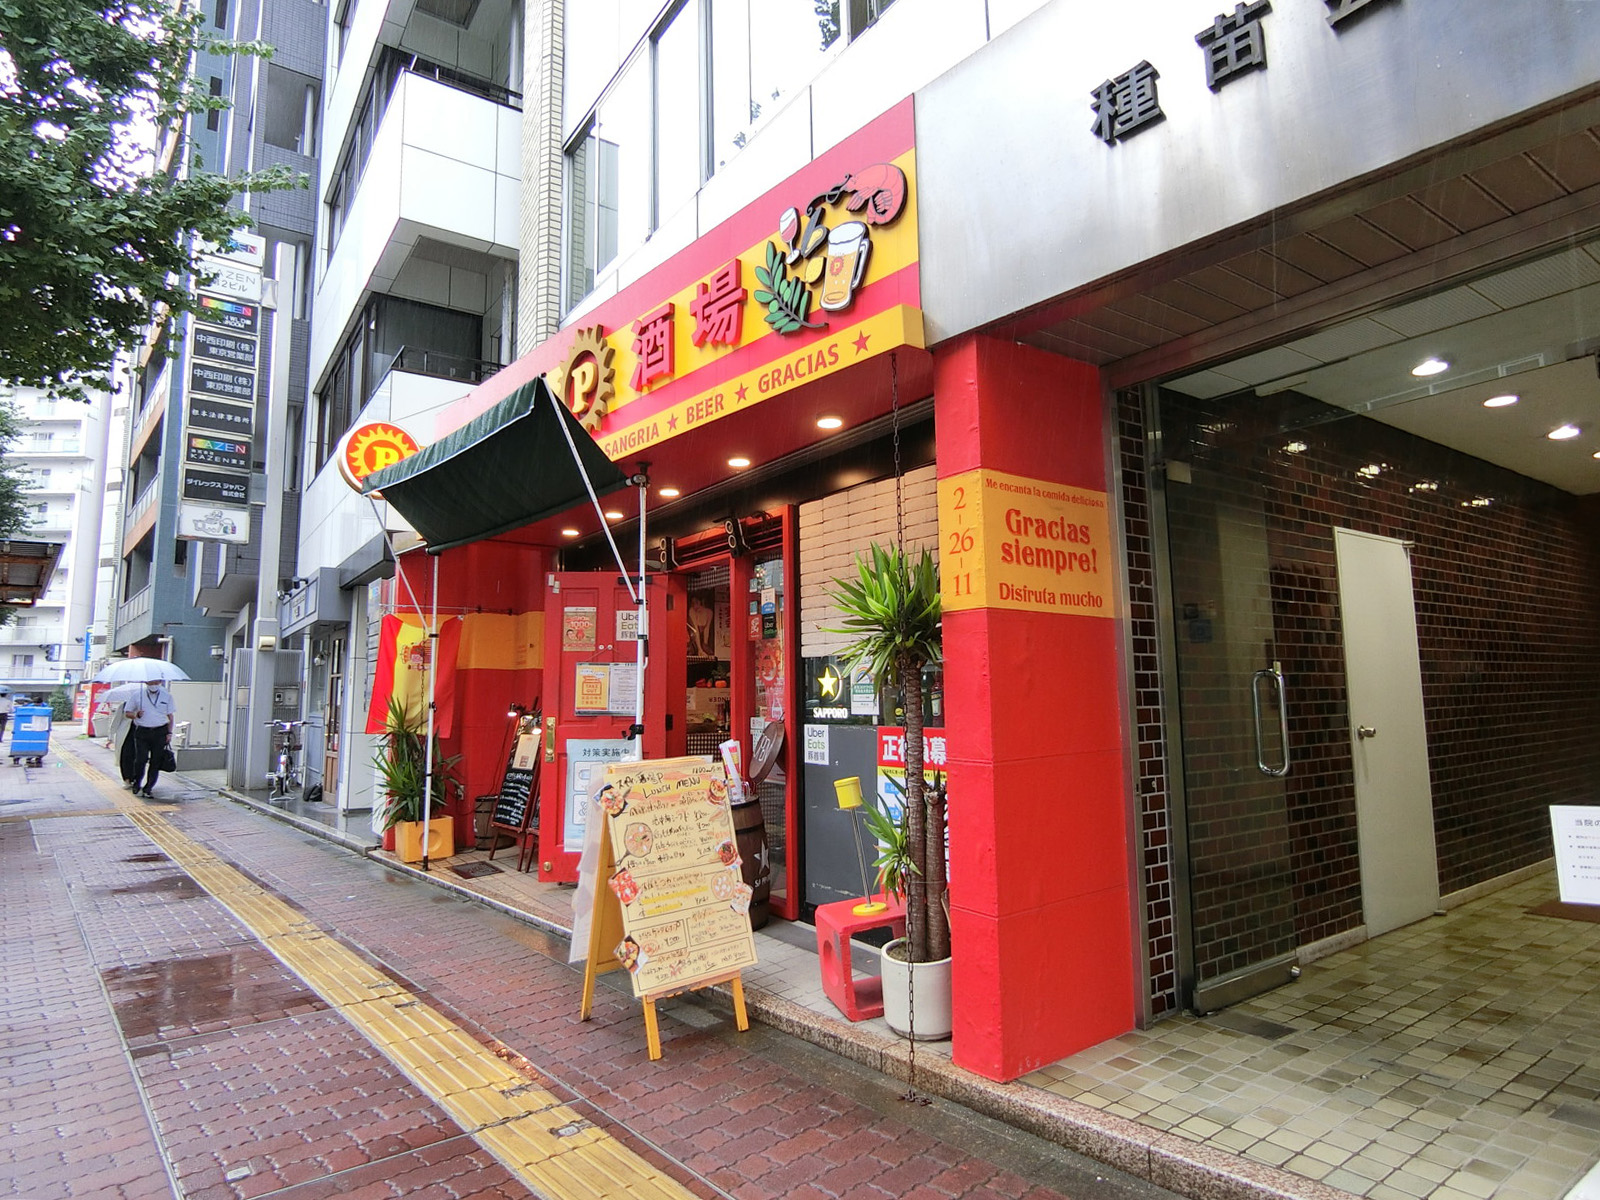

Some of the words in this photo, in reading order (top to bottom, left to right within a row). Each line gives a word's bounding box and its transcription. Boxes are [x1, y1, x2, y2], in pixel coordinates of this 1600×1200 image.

[571, 362, 597, 414] P
[629, 258, 748, 393] 酒場
[603, 421, 660, 457] SANGRIA
[686, 392, 725, 424] BEER
[758, 342, 840, 394] GRACIAS
[192, 437, 246, 454] KAZEN
[372, 445, 399, 471] P
[222, 490, 246, 499] 株式会社
[985, 478, 998, 490] Me
[999, 481, 1032, 496] encanta
[1033, 486, 1041, 497] la
[1042, 490, 1070, 502] comida
[1005, 508, 1090, 545] Gracias
[1001, 538, 1098, 576] siempre!
[1060, 592, 1103, 608] mucho
[621, 613, 638, 621] Ube
[621, 622, 638, 630] Eat
[813, 707, 848, 718] SAPPORO
[807, 727, 825, 738] Uber
[807, 739, 826, 750] Eats
